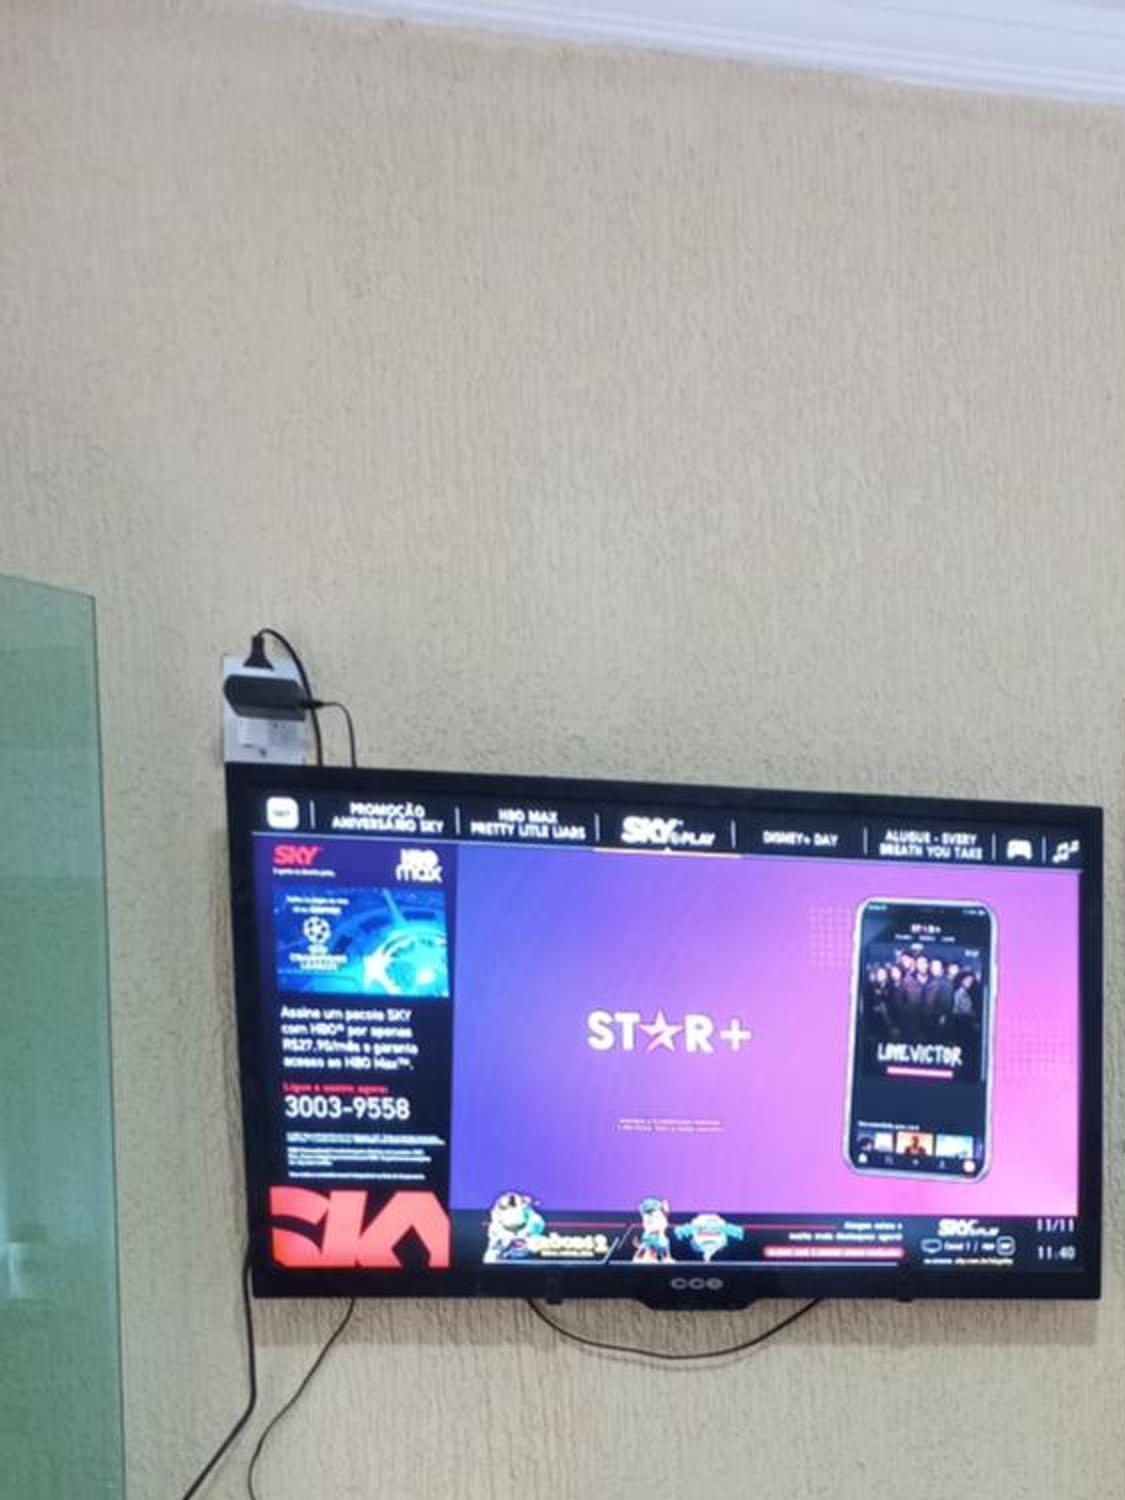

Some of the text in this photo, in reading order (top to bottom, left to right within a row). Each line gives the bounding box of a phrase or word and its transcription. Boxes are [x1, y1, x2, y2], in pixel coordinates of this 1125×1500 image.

[498, 808, 558, 824] HBO MAX
[420, 819, 444, 833] SKY
[470, 820, 515, 836] PRETTY
[814, 832, 839, 847] DAY
[884, 829, 931, 844] ALUGUE
[273, 844, 320, 866] SKY
[926, 845, 951, 858] YOU
[954, 847, 982, 860] TAKE
[285, 1095, 411, 1120] 3003-9558
[1037, 1218, 1074, 1233] 11/11
